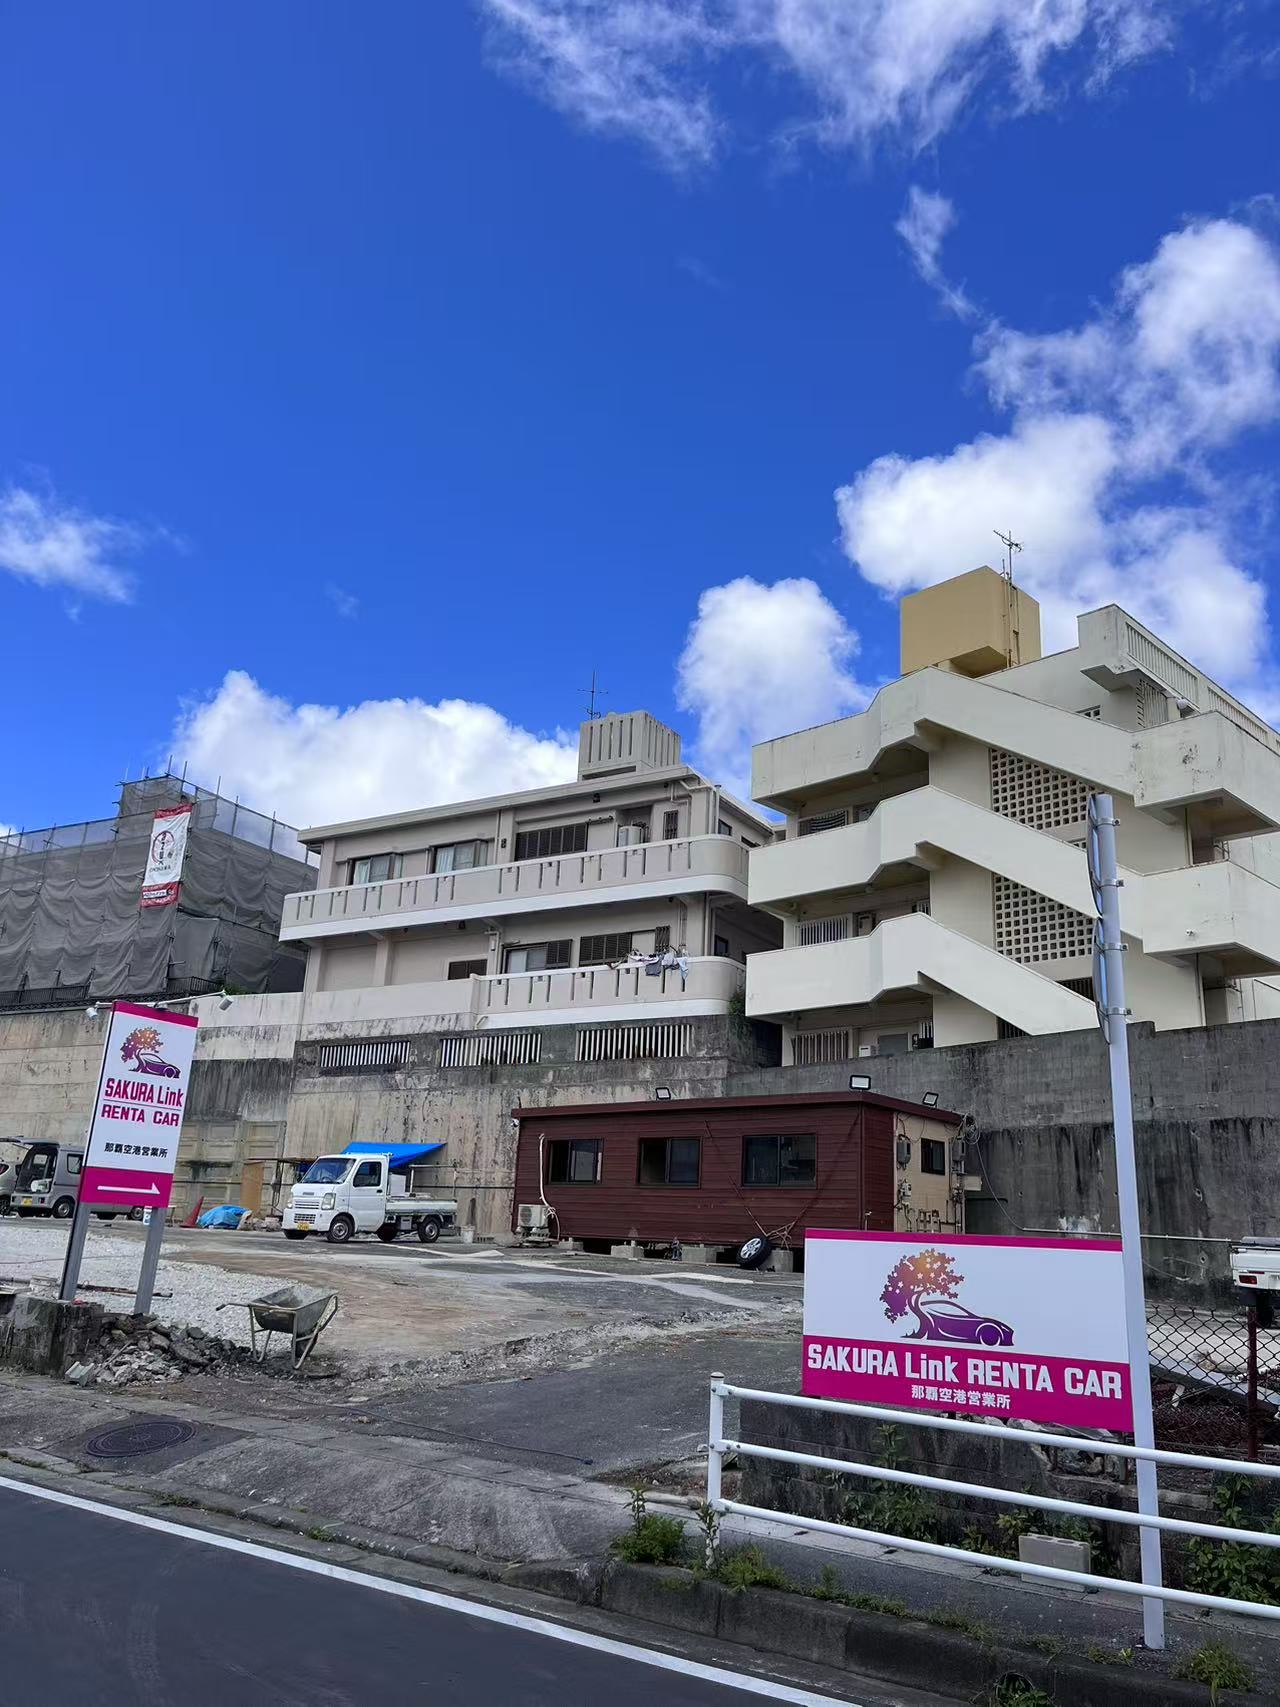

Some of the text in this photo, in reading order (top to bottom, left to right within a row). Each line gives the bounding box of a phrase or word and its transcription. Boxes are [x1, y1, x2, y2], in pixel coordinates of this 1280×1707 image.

[105, 1078, 184, 1107] SAKURA Link
[101, 1105, 180, 1126] RENTA CAR
[105, 1142, 168, 1158] 那覇空港営業所
[807, 1344, 1122, 1399] SAKURA Link RENTA CAR
[911, 1385, 1011, 1409] 那覇空港営業所
